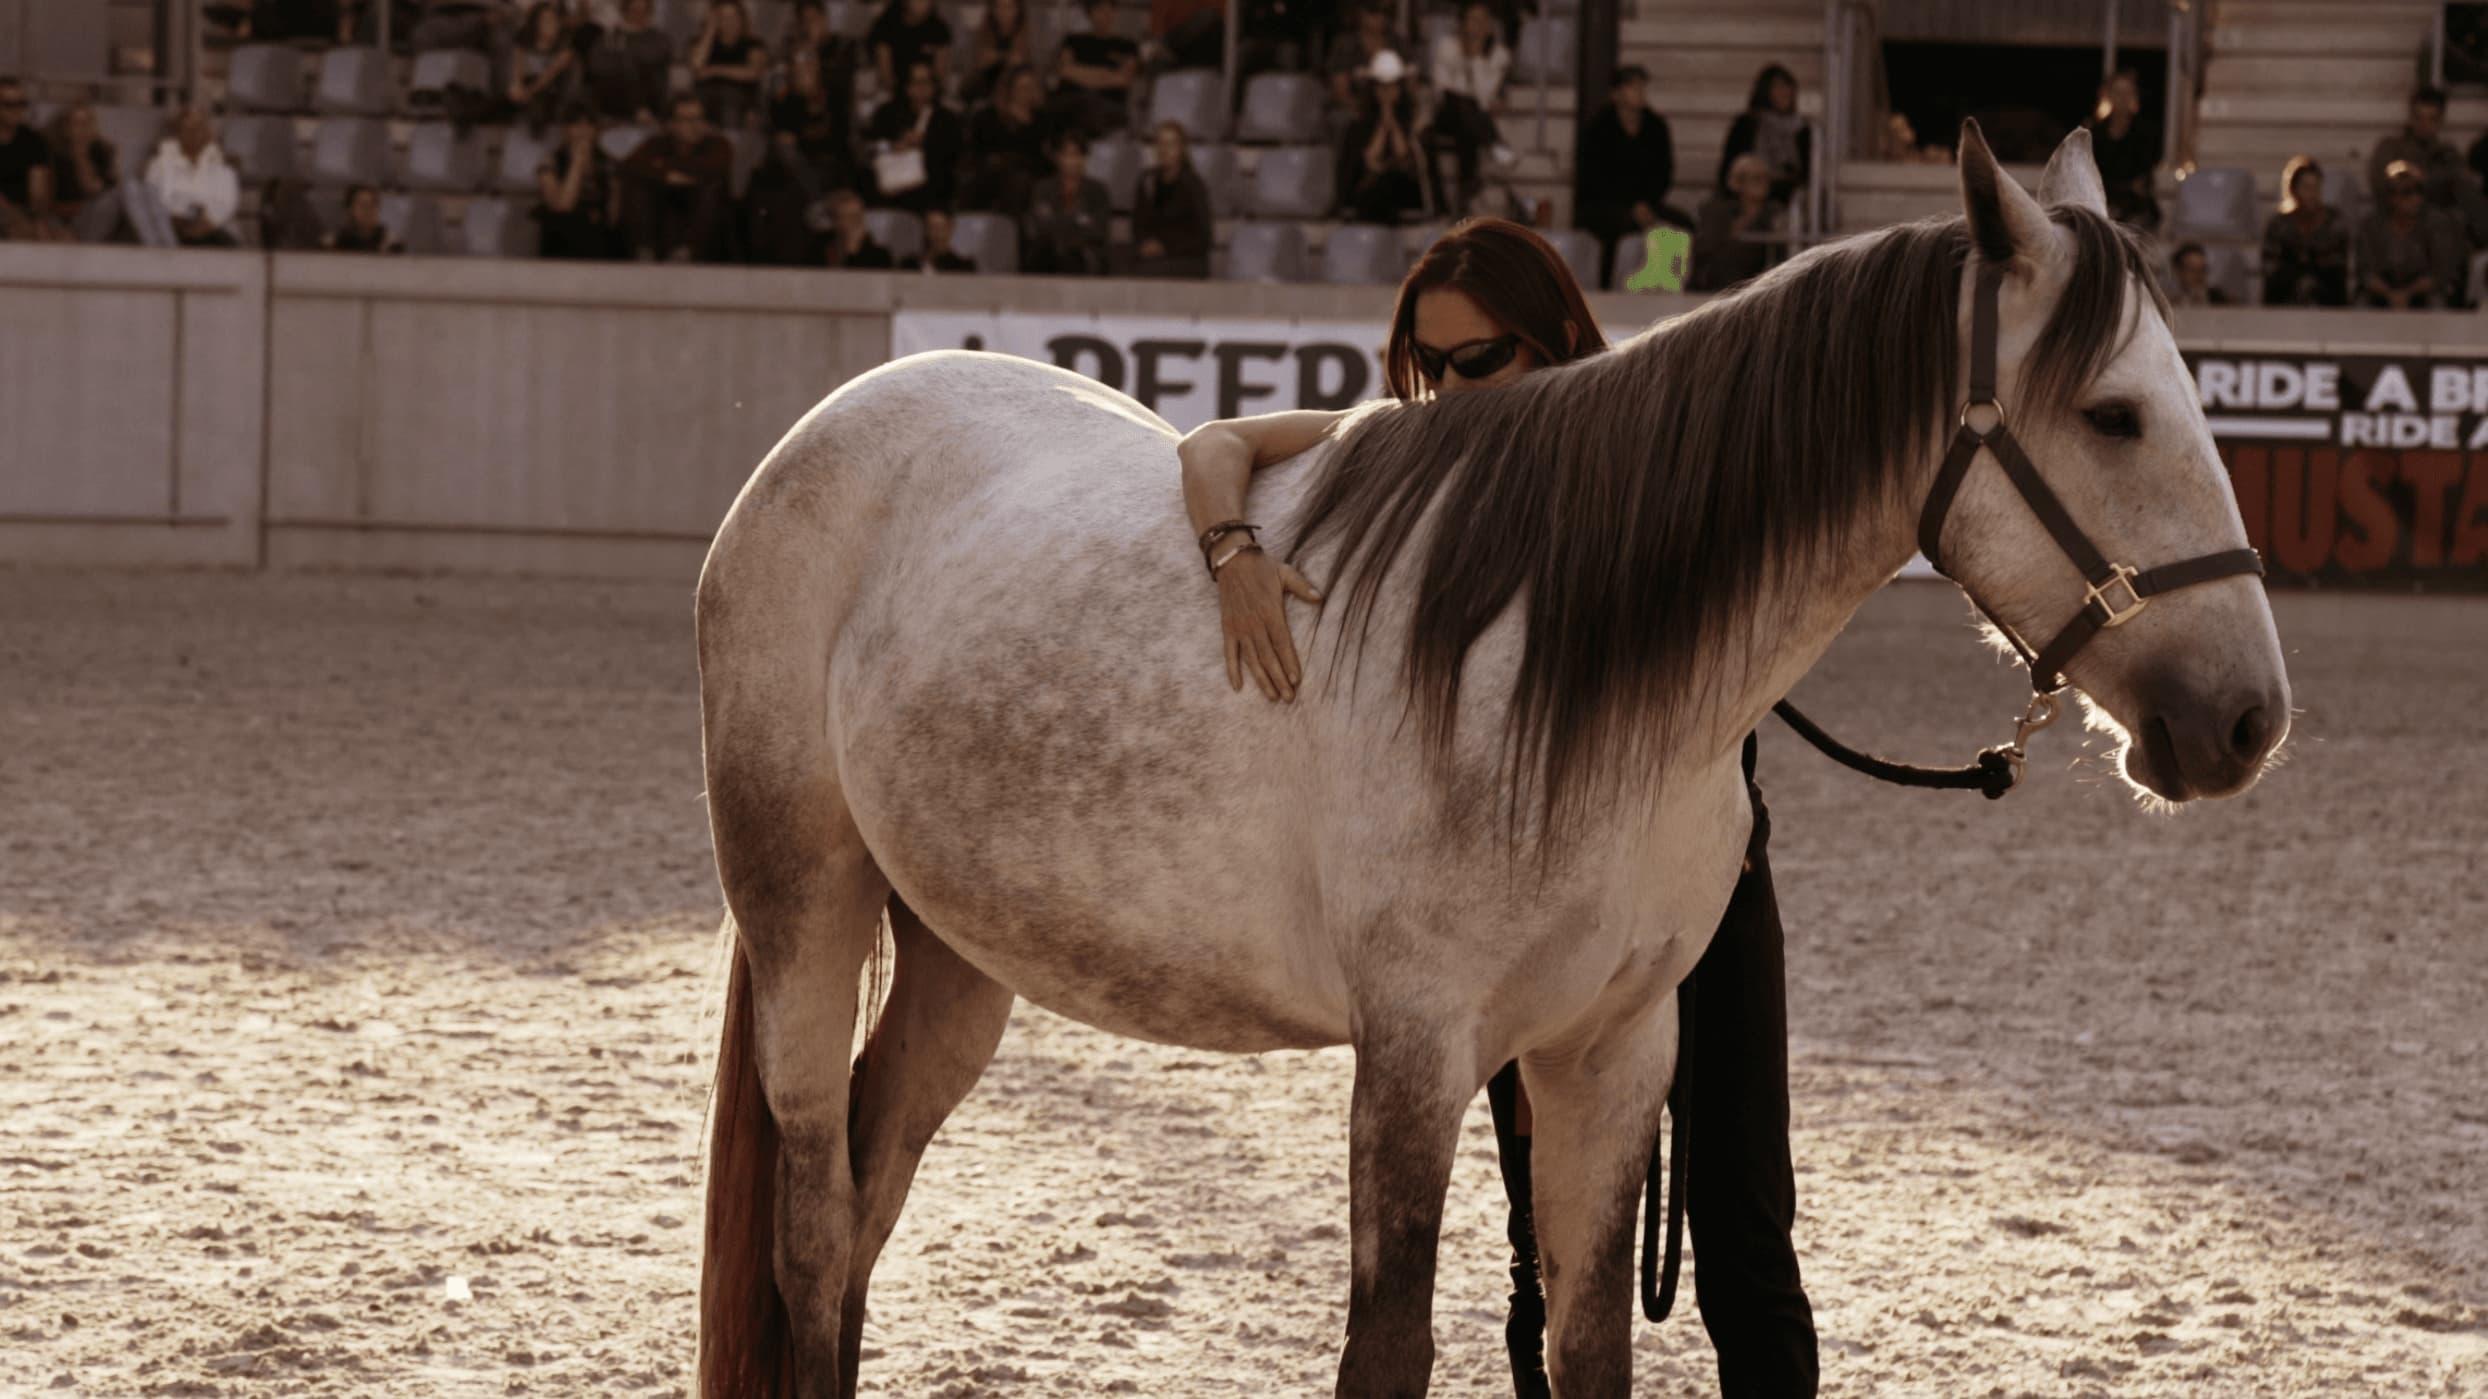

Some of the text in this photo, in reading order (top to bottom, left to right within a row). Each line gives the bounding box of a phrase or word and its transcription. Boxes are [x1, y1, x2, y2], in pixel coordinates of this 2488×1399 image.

[2199, 360, 2342, 411] RIDE
[2364, 363, 2419, 413] A
[2340, 412, 2460, 449] RIDE
